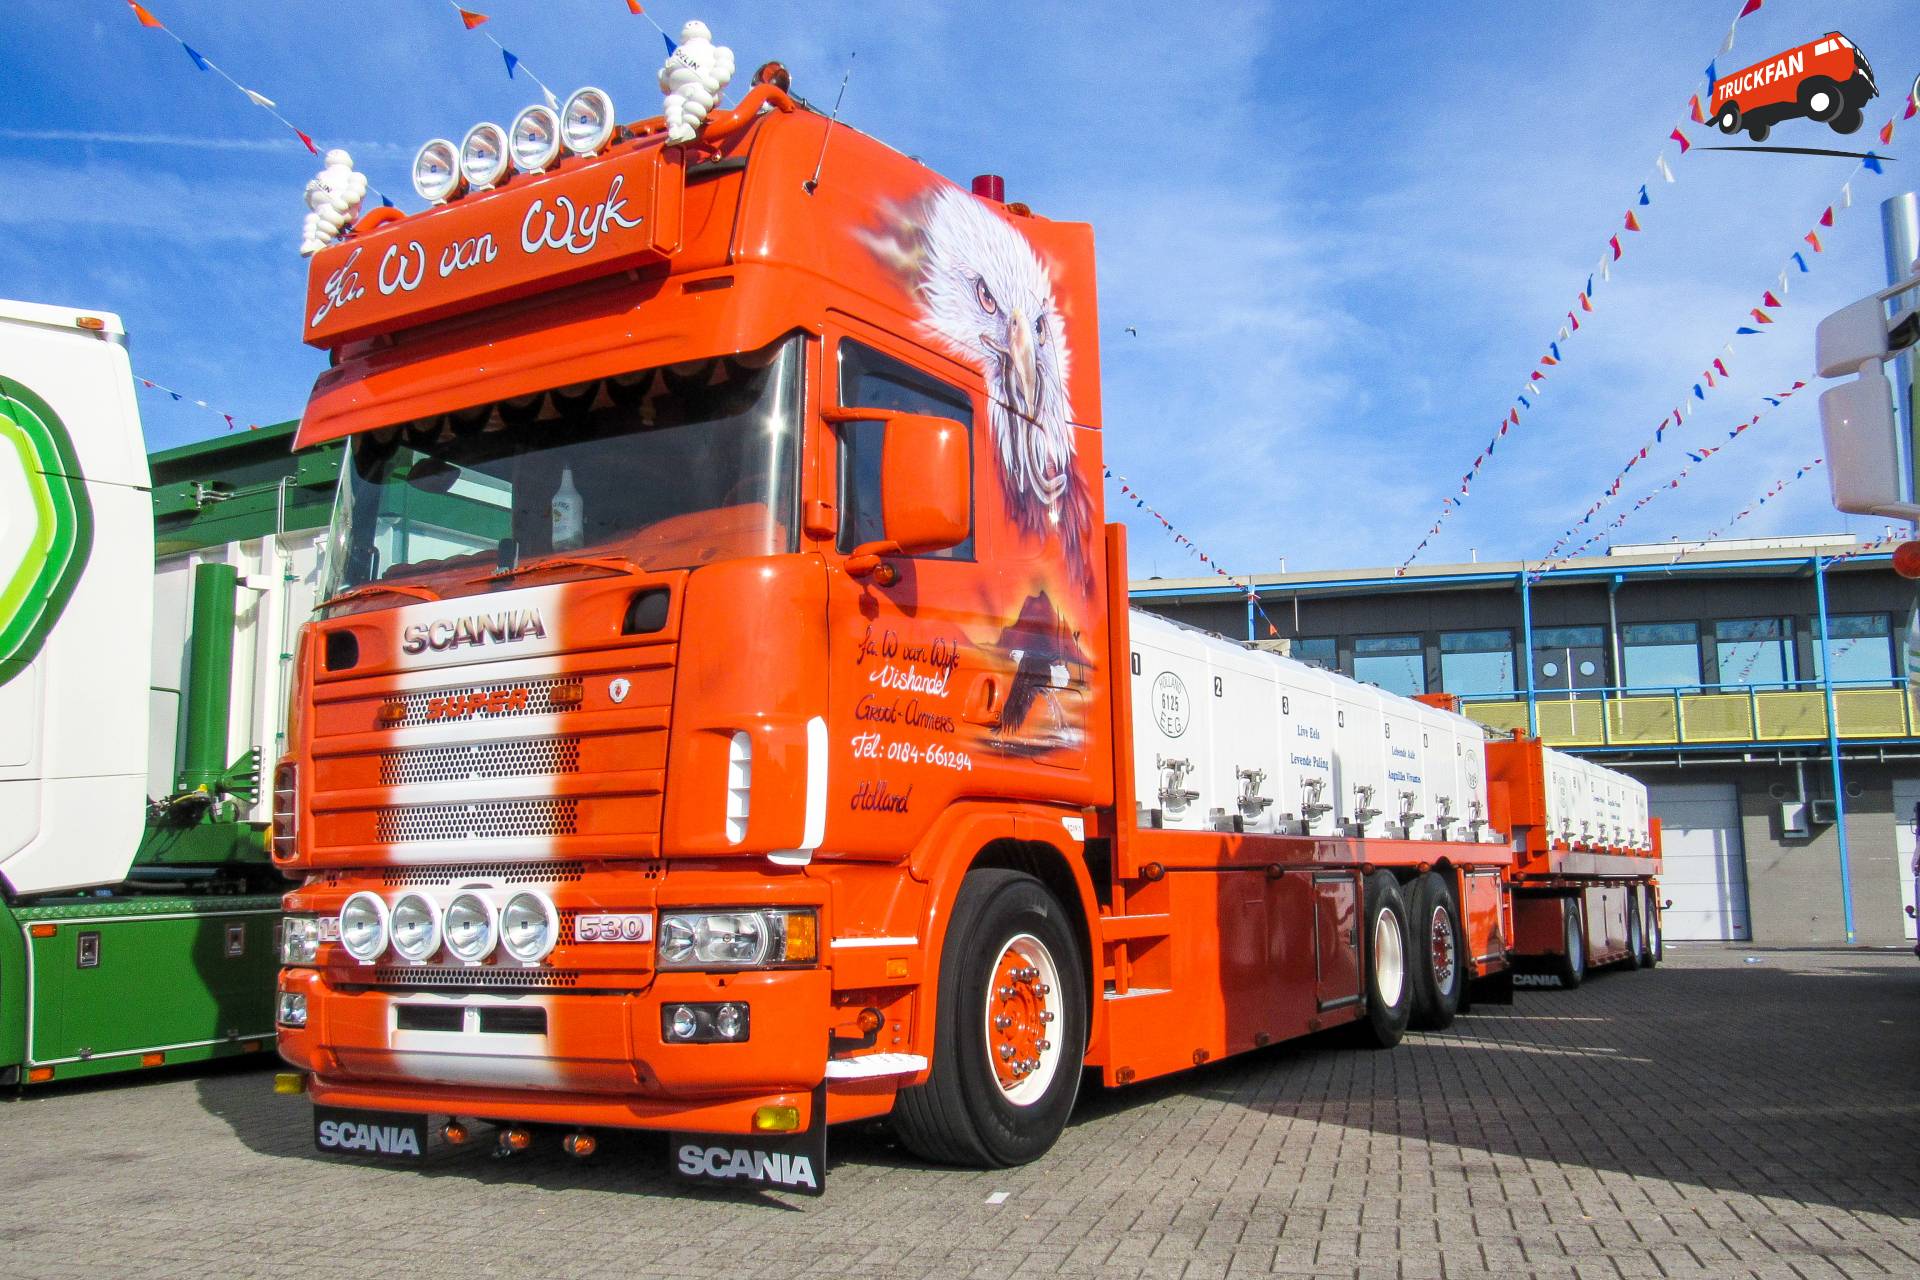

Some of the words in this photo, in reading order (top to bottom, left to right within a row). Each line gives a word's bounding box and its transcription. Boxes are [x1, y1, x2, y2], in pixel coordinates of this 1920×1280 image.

[377, 240, 426, 296] W
[439, 232, 498, 278] van
[520, 173, 644, 255] Wyk
[402, 606, 547, 656] SCANIA
[903, 645, 928, 663] van
[869, 664, 950, 698] Vishandel
[1214, 676, 1223, 697] 2
[425, 688, 529, 720] SUPER
[1161, 693, 1179, 712] 6125
[887, 742, 973, 771] 0184-661294
[850, 780, 913, 814] Holland
[578, 915, 645, 941] 530
[1512, 974, 1563, 986] CANIA
[319, 1119, 421, 1156] SCANIA
[677, 1144, 818, 1189] SCANIA
